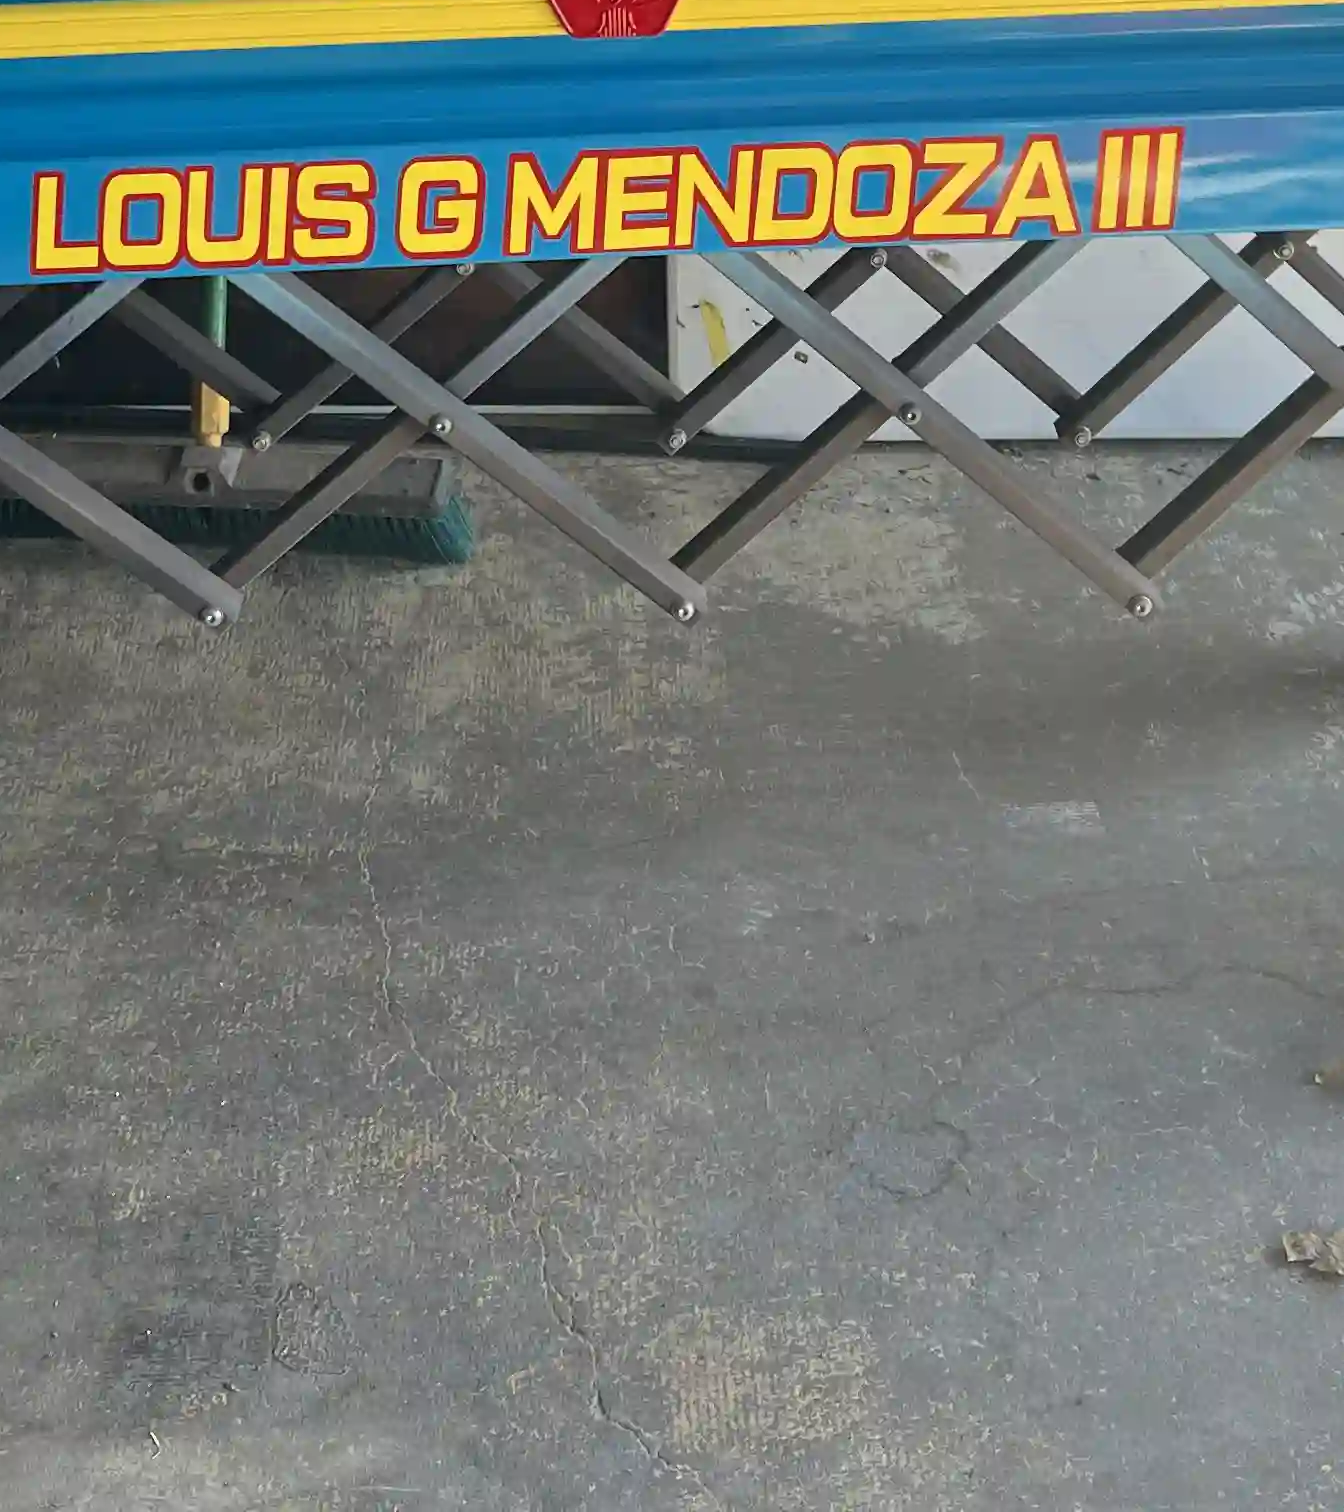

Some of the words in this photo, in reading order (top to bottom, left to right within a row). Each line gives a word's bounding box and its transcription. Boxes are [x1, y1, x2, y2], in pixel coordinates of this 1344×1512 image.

[30, 159, 377, 275] LOUIS
[395, 154, 486, 260] G
[502, 134, 1079, 257] MENDOZA
[1092, 126, 1185, 233] III
